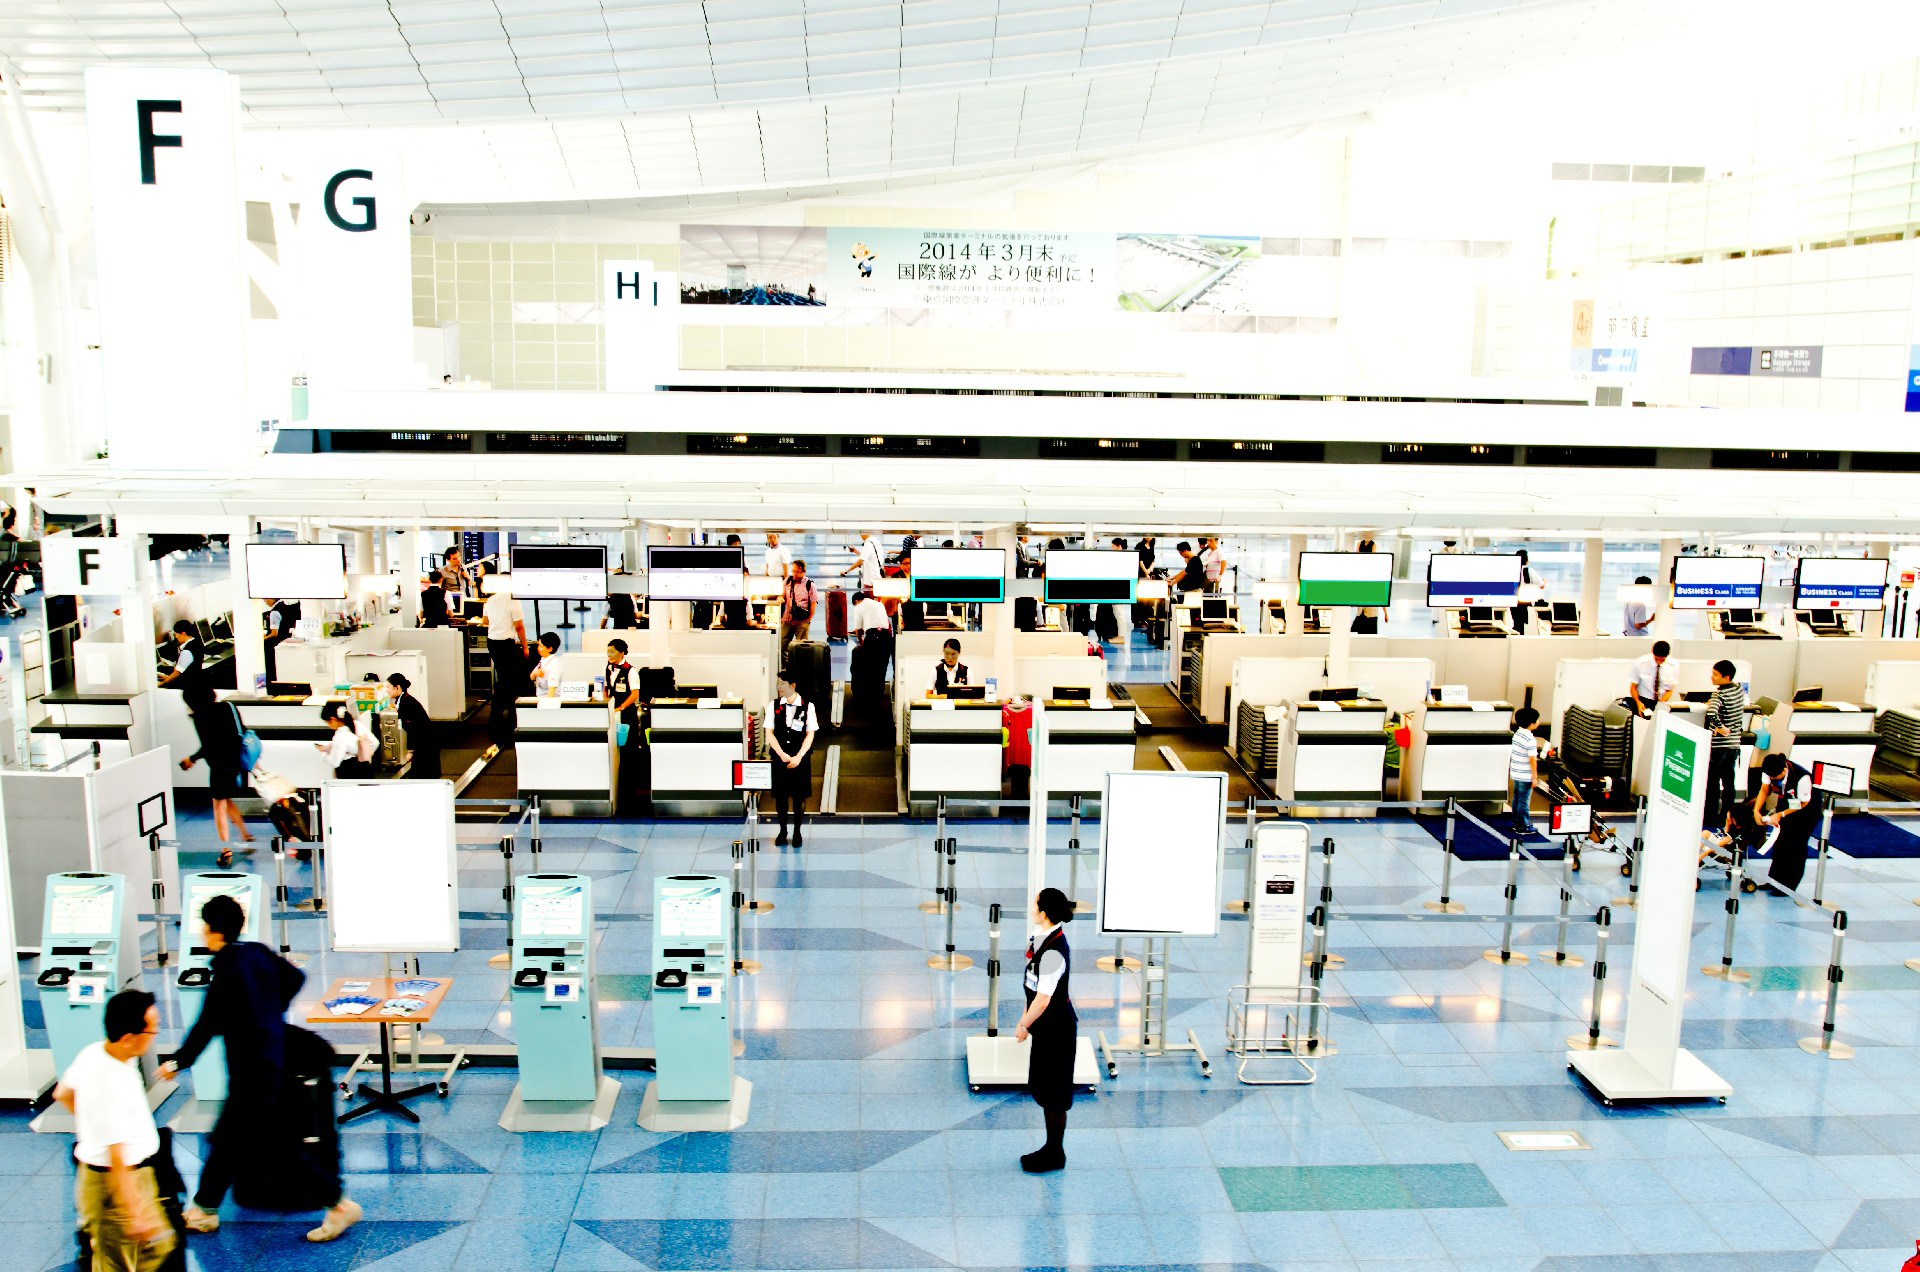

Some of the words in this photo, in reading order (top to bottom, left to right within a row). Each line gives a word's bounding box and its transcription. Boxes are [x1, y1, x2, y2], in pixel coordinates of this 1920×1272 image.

[136, 99, 183, 184] F
[323, 168, 377, 232] G
[616, 270, 639, 299] H
[79, 549, 100, 585] F
